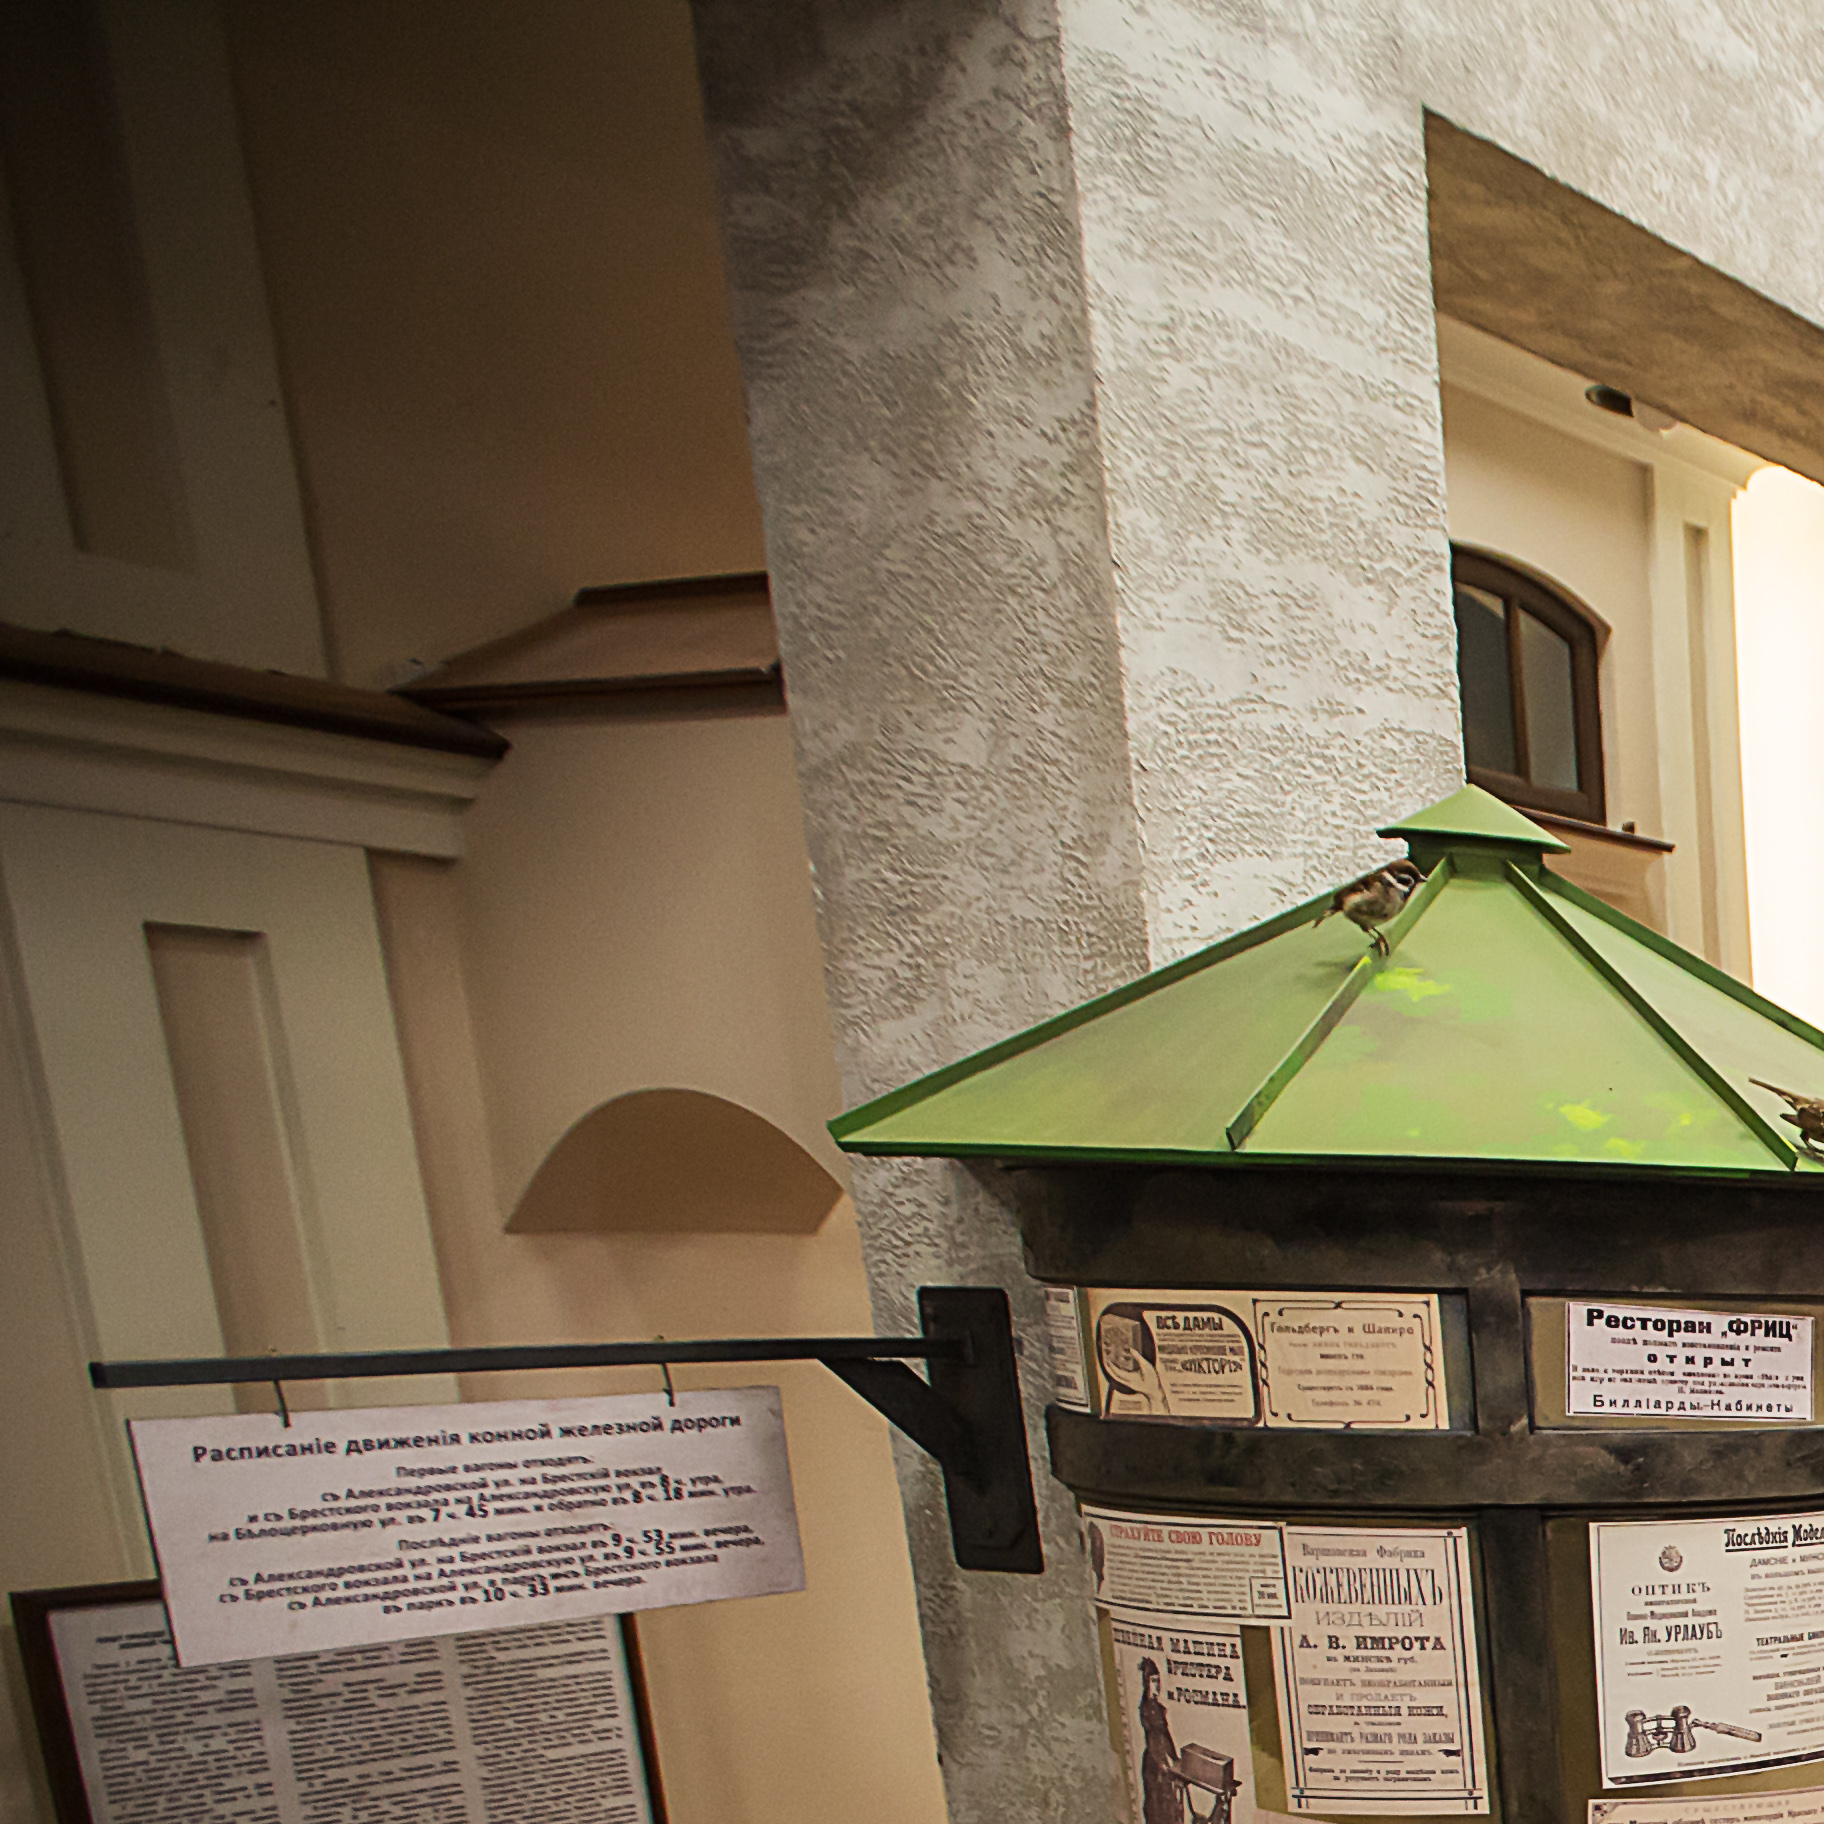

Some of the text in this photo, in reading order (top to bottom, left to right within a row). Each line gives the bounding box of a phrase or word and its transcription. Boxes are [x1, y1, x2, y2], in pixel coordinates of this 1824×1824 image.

[1182, 1315, 1224, 1332] ДАМЫ
[1362, 1322, 1414, 1337] Шапиро
[1586, 1308, 1713, 1338] Ресторан
[1646, 1353, 1752, 1369] открыт
[192, 1414, 741, 1462] Расписаніе движенія конной железной дороги
[431, 1508, 441, 1522] 7
[464, 1503, 489, 1518] 45
[632, 1488, 643, 1503] 8
[663, 1486, 685, 1500] 18
[611, 1533, 623, 1547] 9
[642, 1529, 664, 1543] 53
[1168, 1529, 1202, 1544] СВОЮ
[1208, 1531, 1262, 1547] ГОЛОВУ
[1724, 1526, 1788, 1547] Послѣднія
[624, 1545, 634, 1559] 9
[655, 1541, 675, 1556] 55
[1376, 1545, 1425, 1562] Фабрика
[483, 1587, 506, 1602] 10
[528, 1582, 550, 1597] 33
[1292, 1565, 1443, 1606] КОЖЕВЕННЫХЪ
[1631, 1582, 1710, 1596] ОПТИКЪ
[1315, 1609, 1424, 1628] ИЗДѢЛІЙ
[1299, 1634, 1447, 1651] А. В. ИМРОТА
[1619, 1622, 1722, 1645] Ив. Як. УРЛАУБЪ
[1170, 1636, 1240, 1659] МАШИНА
